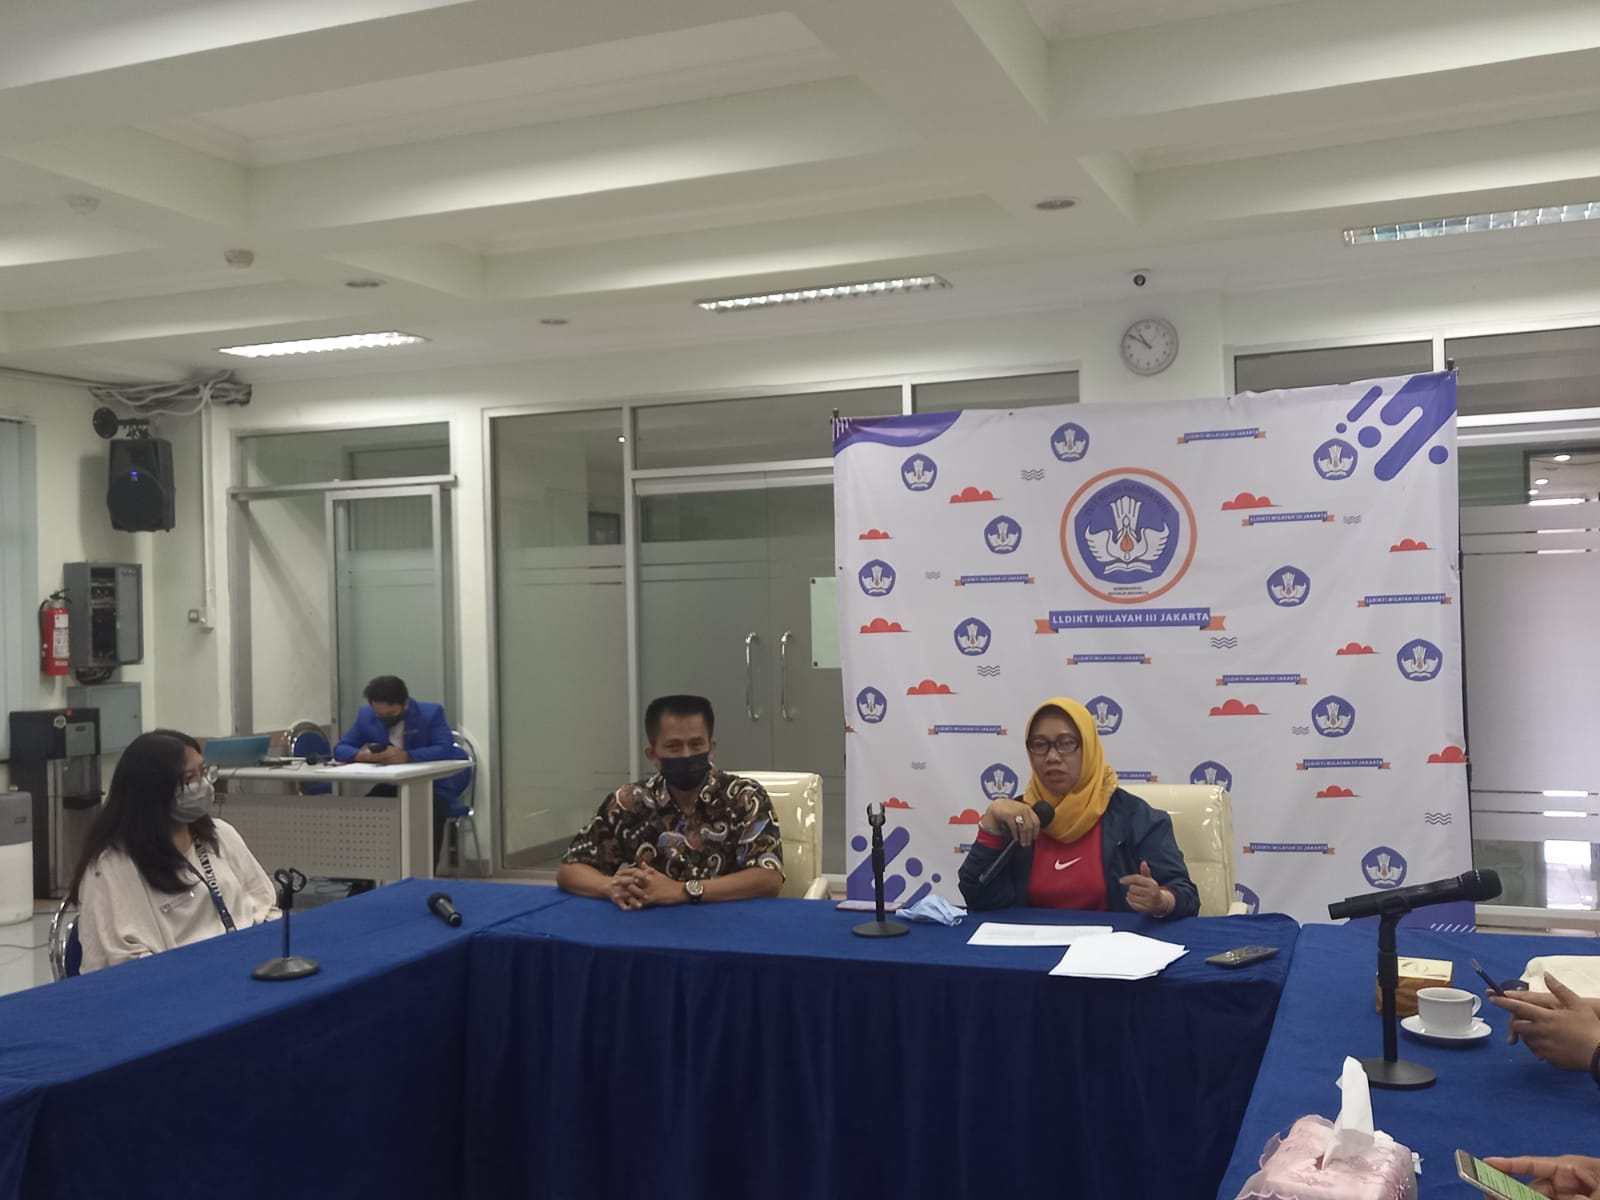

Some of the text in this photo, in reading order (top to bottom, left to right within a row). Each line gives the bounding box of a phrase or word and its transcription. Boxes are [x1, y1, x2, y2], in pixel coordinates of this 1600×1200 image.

[1052, 612, 1209, 624] LLDIKTI WILAYAH III JAKARTA
